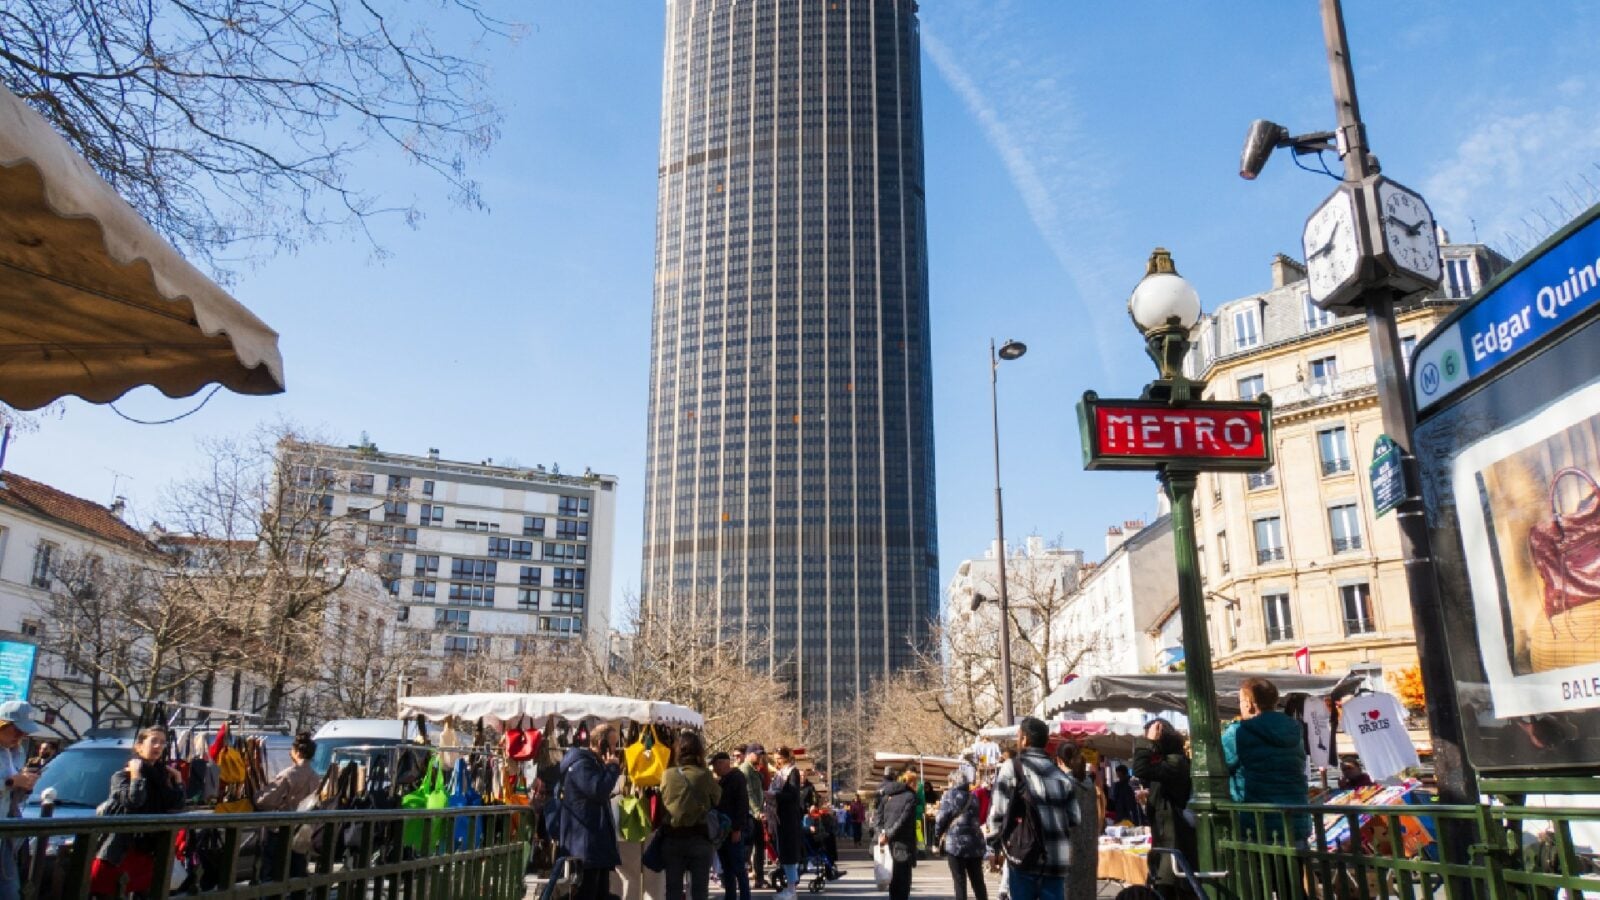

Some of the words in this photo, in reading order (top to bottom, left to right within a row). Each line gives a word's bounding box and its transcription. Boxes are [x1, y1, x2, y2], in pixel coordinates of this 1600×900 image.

[1446, 355, 1456, 376] 6
[1470, 305, 1531, 362] Edgar
[1107, 415, 1252, 450] METRO
[1561, 677, 1600, 700] BALE
[1358, 719, 1390, 735] PARIS
[1360, 711, 1369, 723] I
